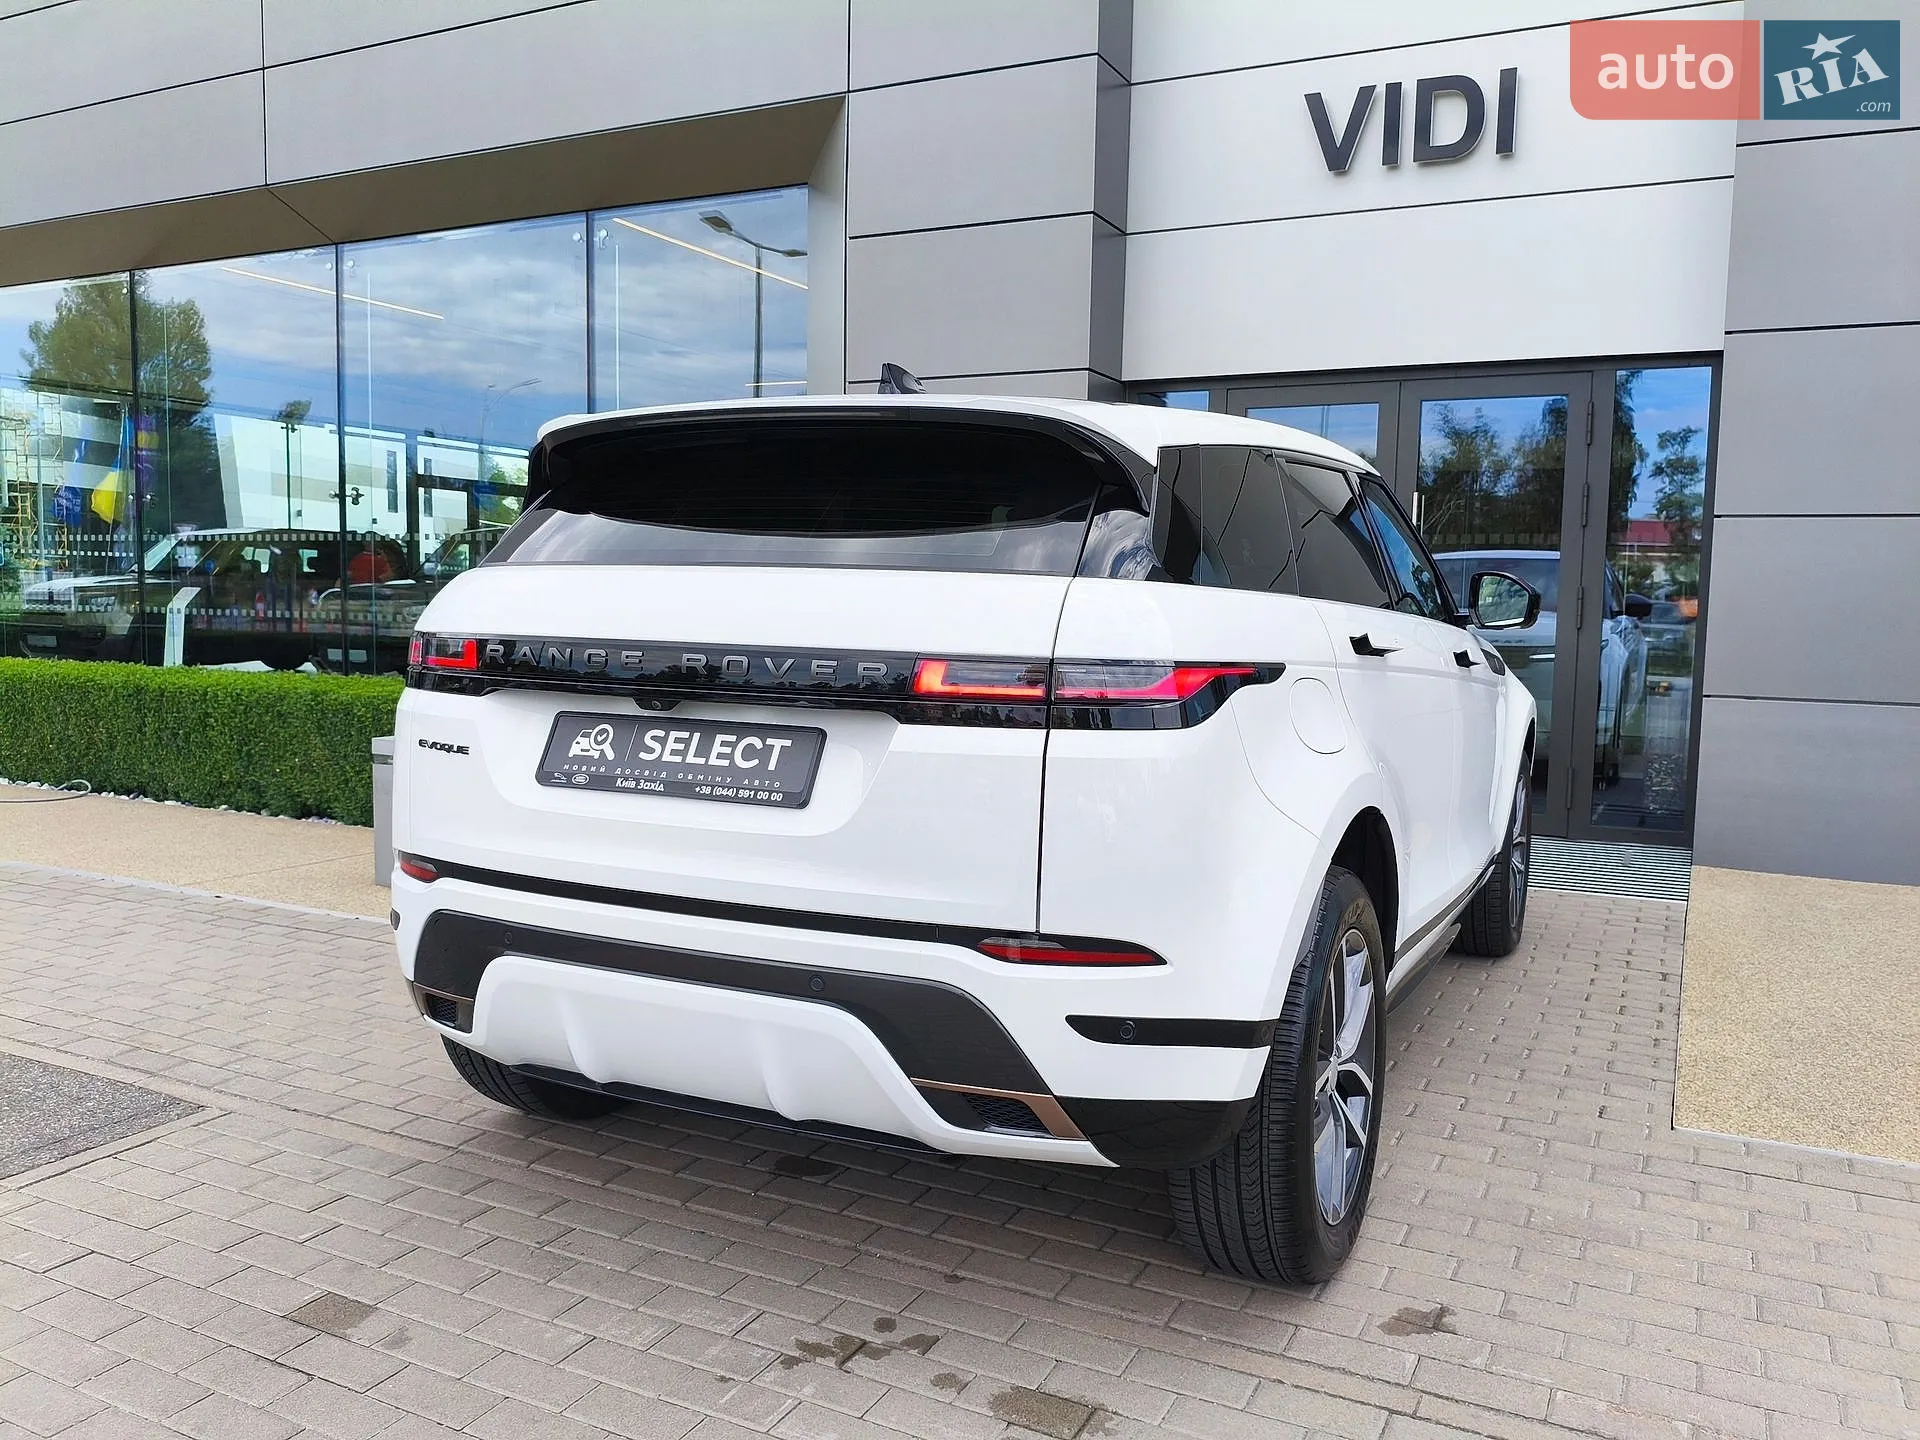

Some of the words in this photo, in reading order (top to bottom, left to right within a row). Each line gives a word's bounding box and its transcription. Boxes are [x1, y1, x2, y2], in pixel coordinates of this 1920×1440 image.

[1304, 67, 1519, 174] VIDI
[485, 643, 645, 672] RANGE
[681, 652, 888, 686] ROVER
[638, 729, 792, 771] SELECT
[563, 764, 607, 773] НОВИЙ
[615, 767, 667, 778] ДОСВІД
[677, 773, 732, 783] ОБМІНУ
[743, 778, 780, 788] АВТО
[615, 777, 636, 788] Київ
[637, 779, 665, 792] Захід
[695, 785, 712, 795] +38
[712, 786, 736, 797] (044)
[737, 789, 755, 799] 591
[756, 790, 769, 800] 00
[770, 792, 783, 801] 00
